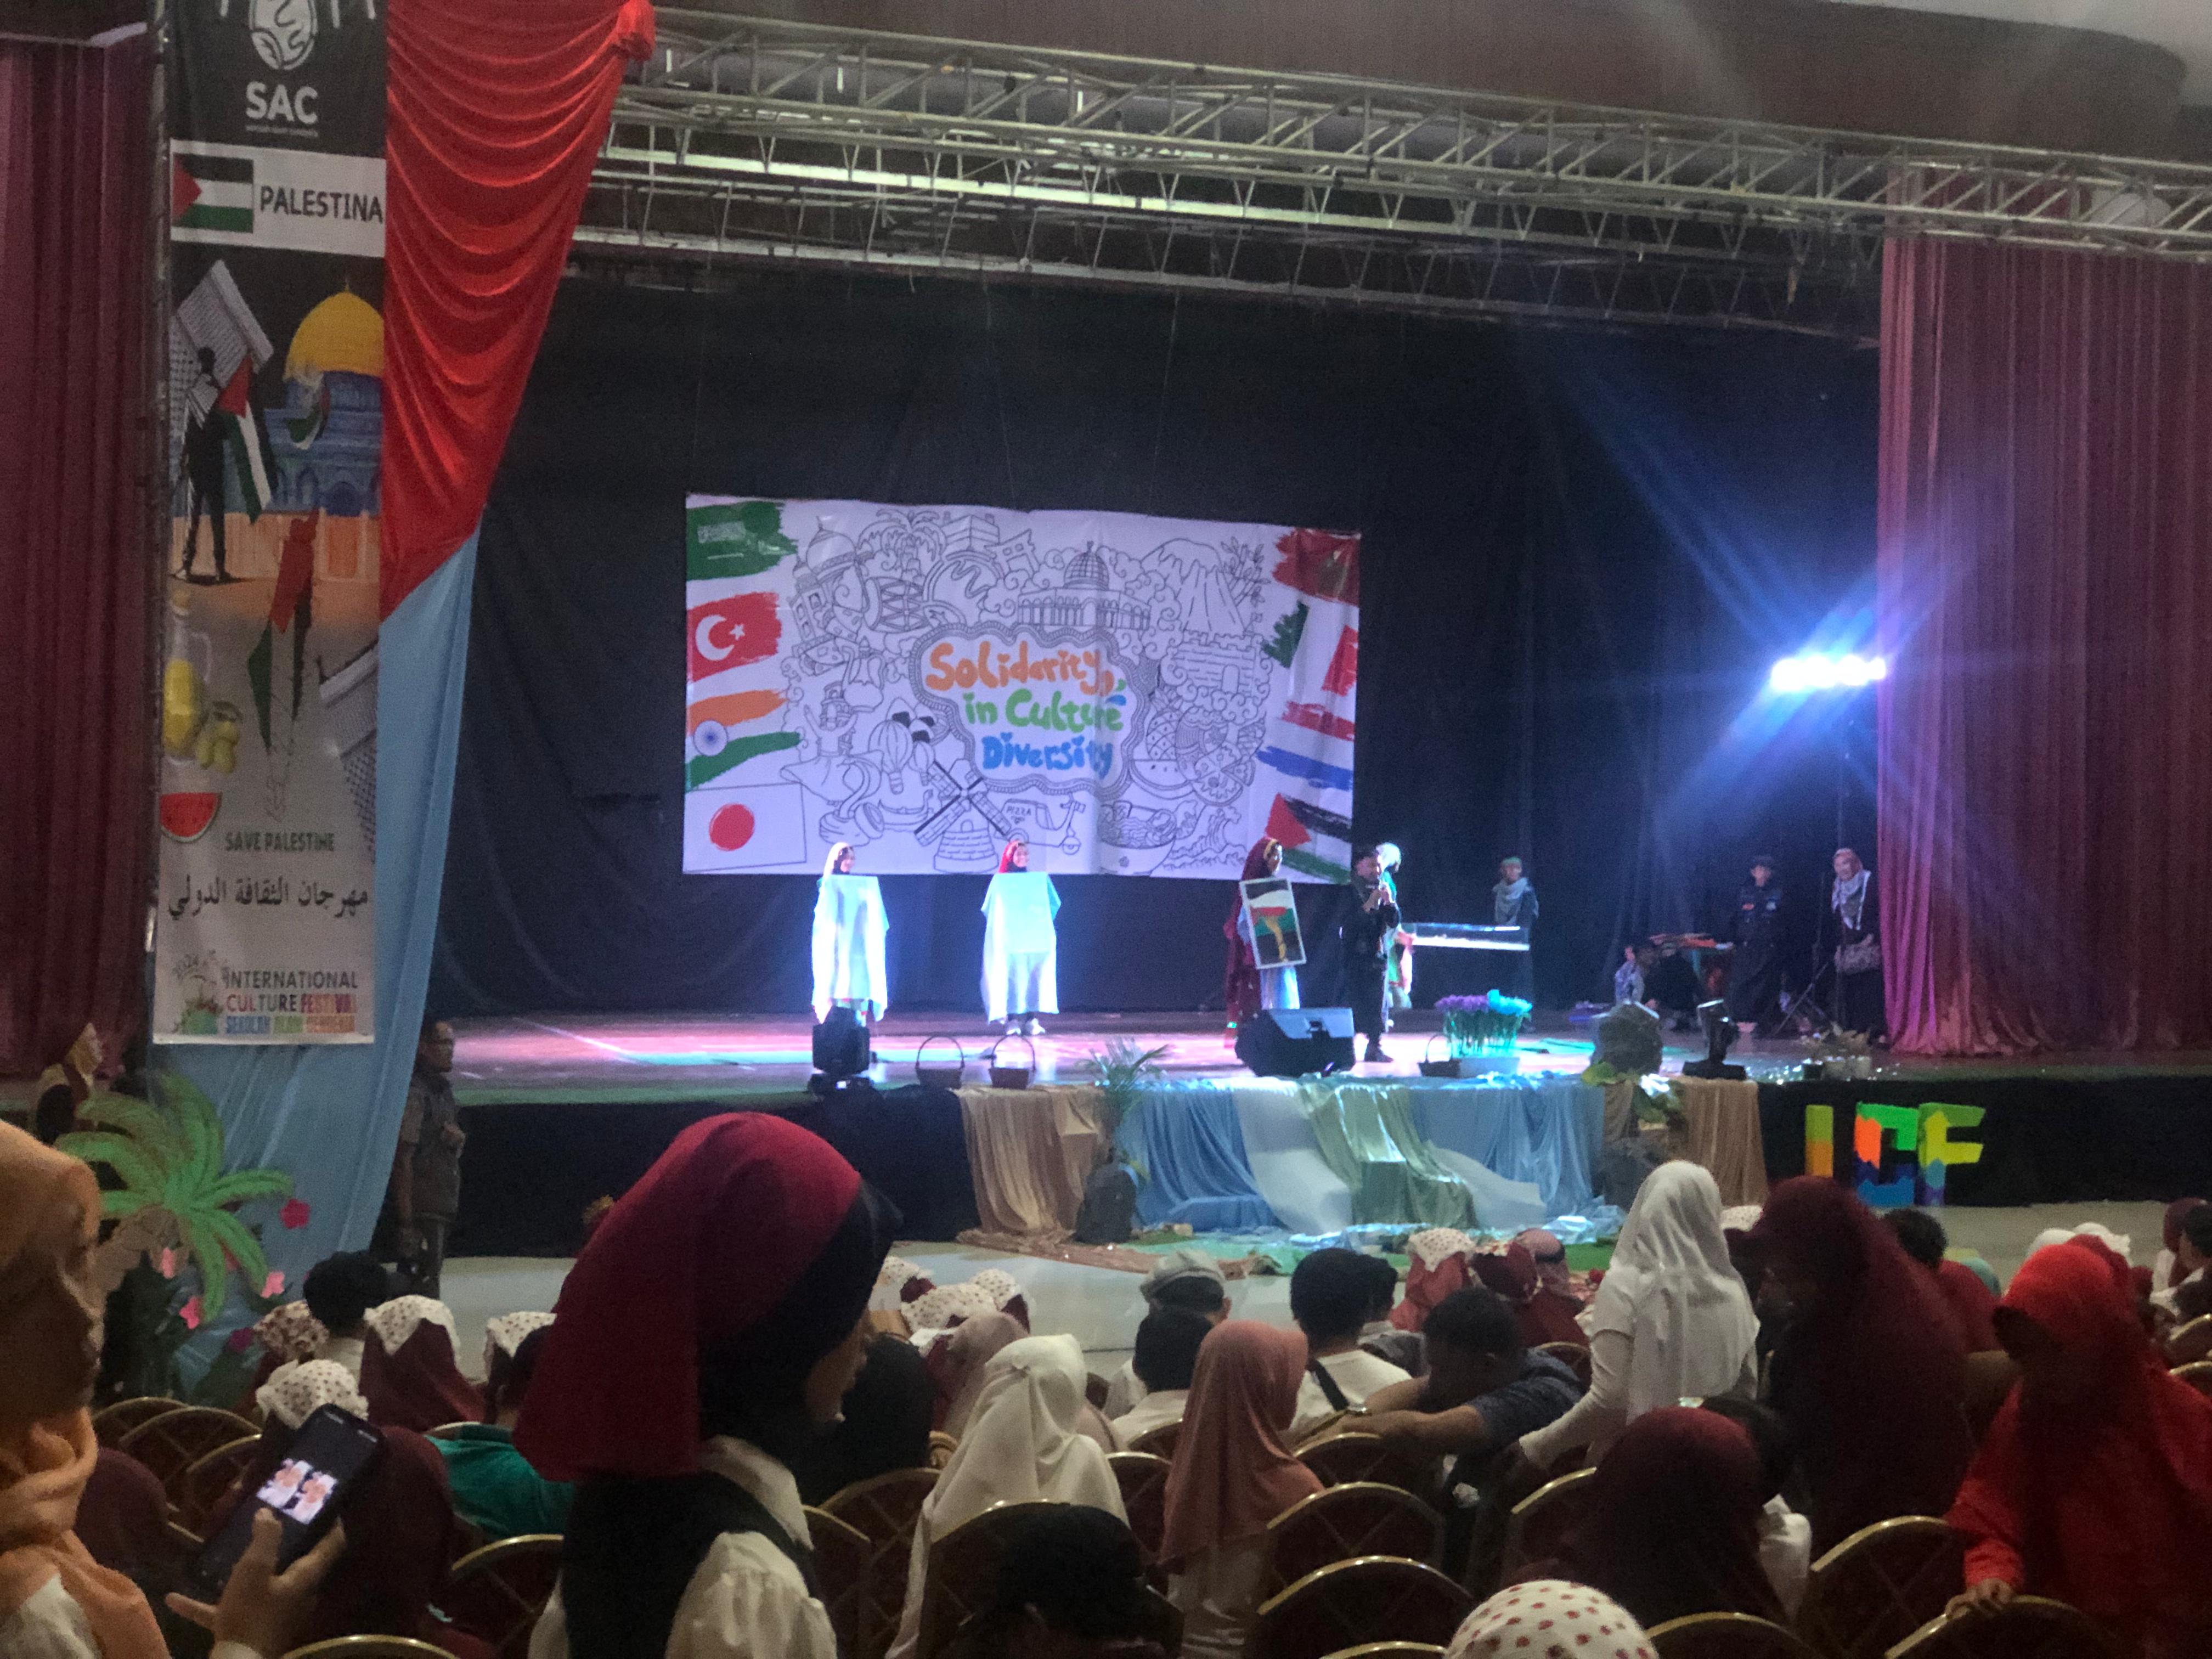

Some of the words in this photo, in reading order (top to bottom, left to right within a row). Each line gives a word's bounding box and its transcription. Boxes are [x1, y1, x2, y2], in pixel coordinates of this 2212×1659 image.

[246, 81, 318, 124] SAC
[259, 185, 383, 224] PALESTINA
[925, 639, 1101, 695] Solidarity
[963, 692, 997, 725] in
[1005, 688, 1124, 733] Culture
[981, 731, 1113, 780] Diversity
[226, 994, 297, 1013] CULTURE
